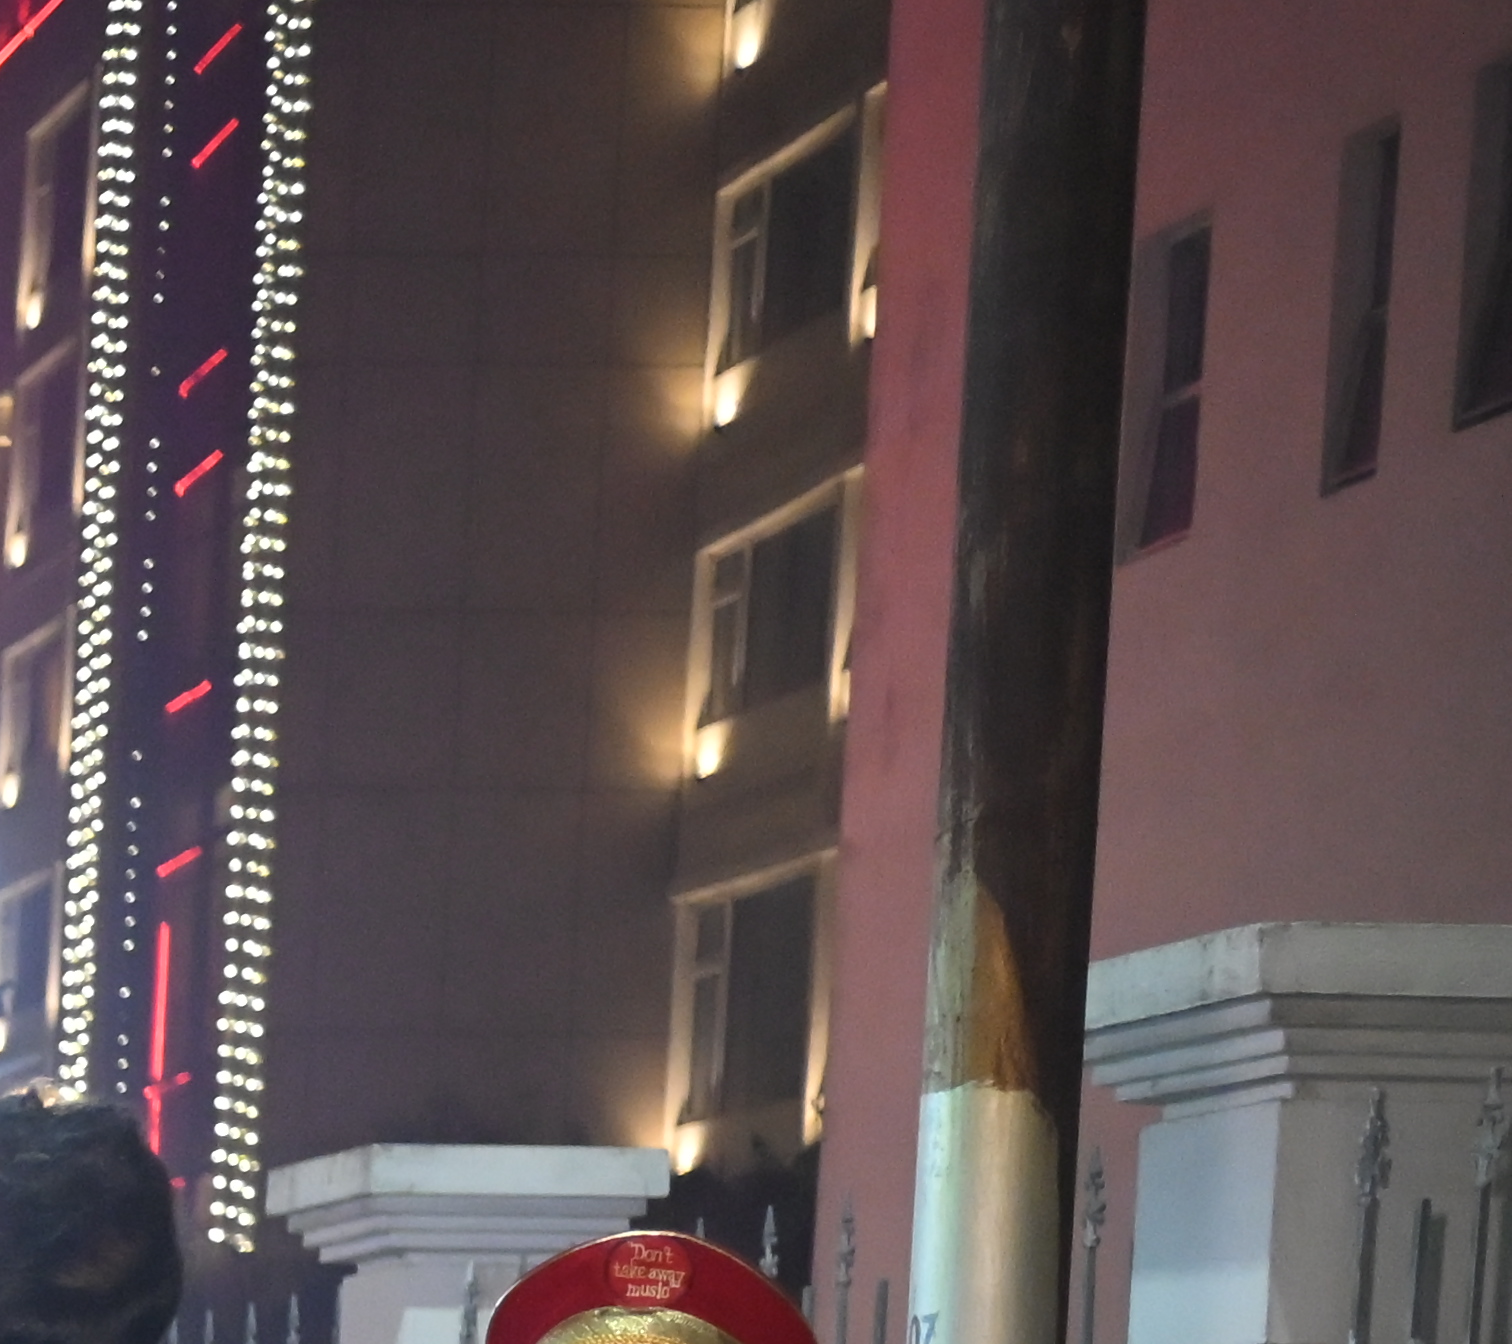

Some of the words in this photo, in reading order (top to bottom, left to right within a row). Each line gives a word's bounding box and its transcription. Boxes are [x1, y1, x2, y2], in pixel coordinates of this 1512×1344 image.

[614, 1259, 647, 1279] take
[648, 1267, 686, 1288] away
[626, 1281, 670, 1299] music
